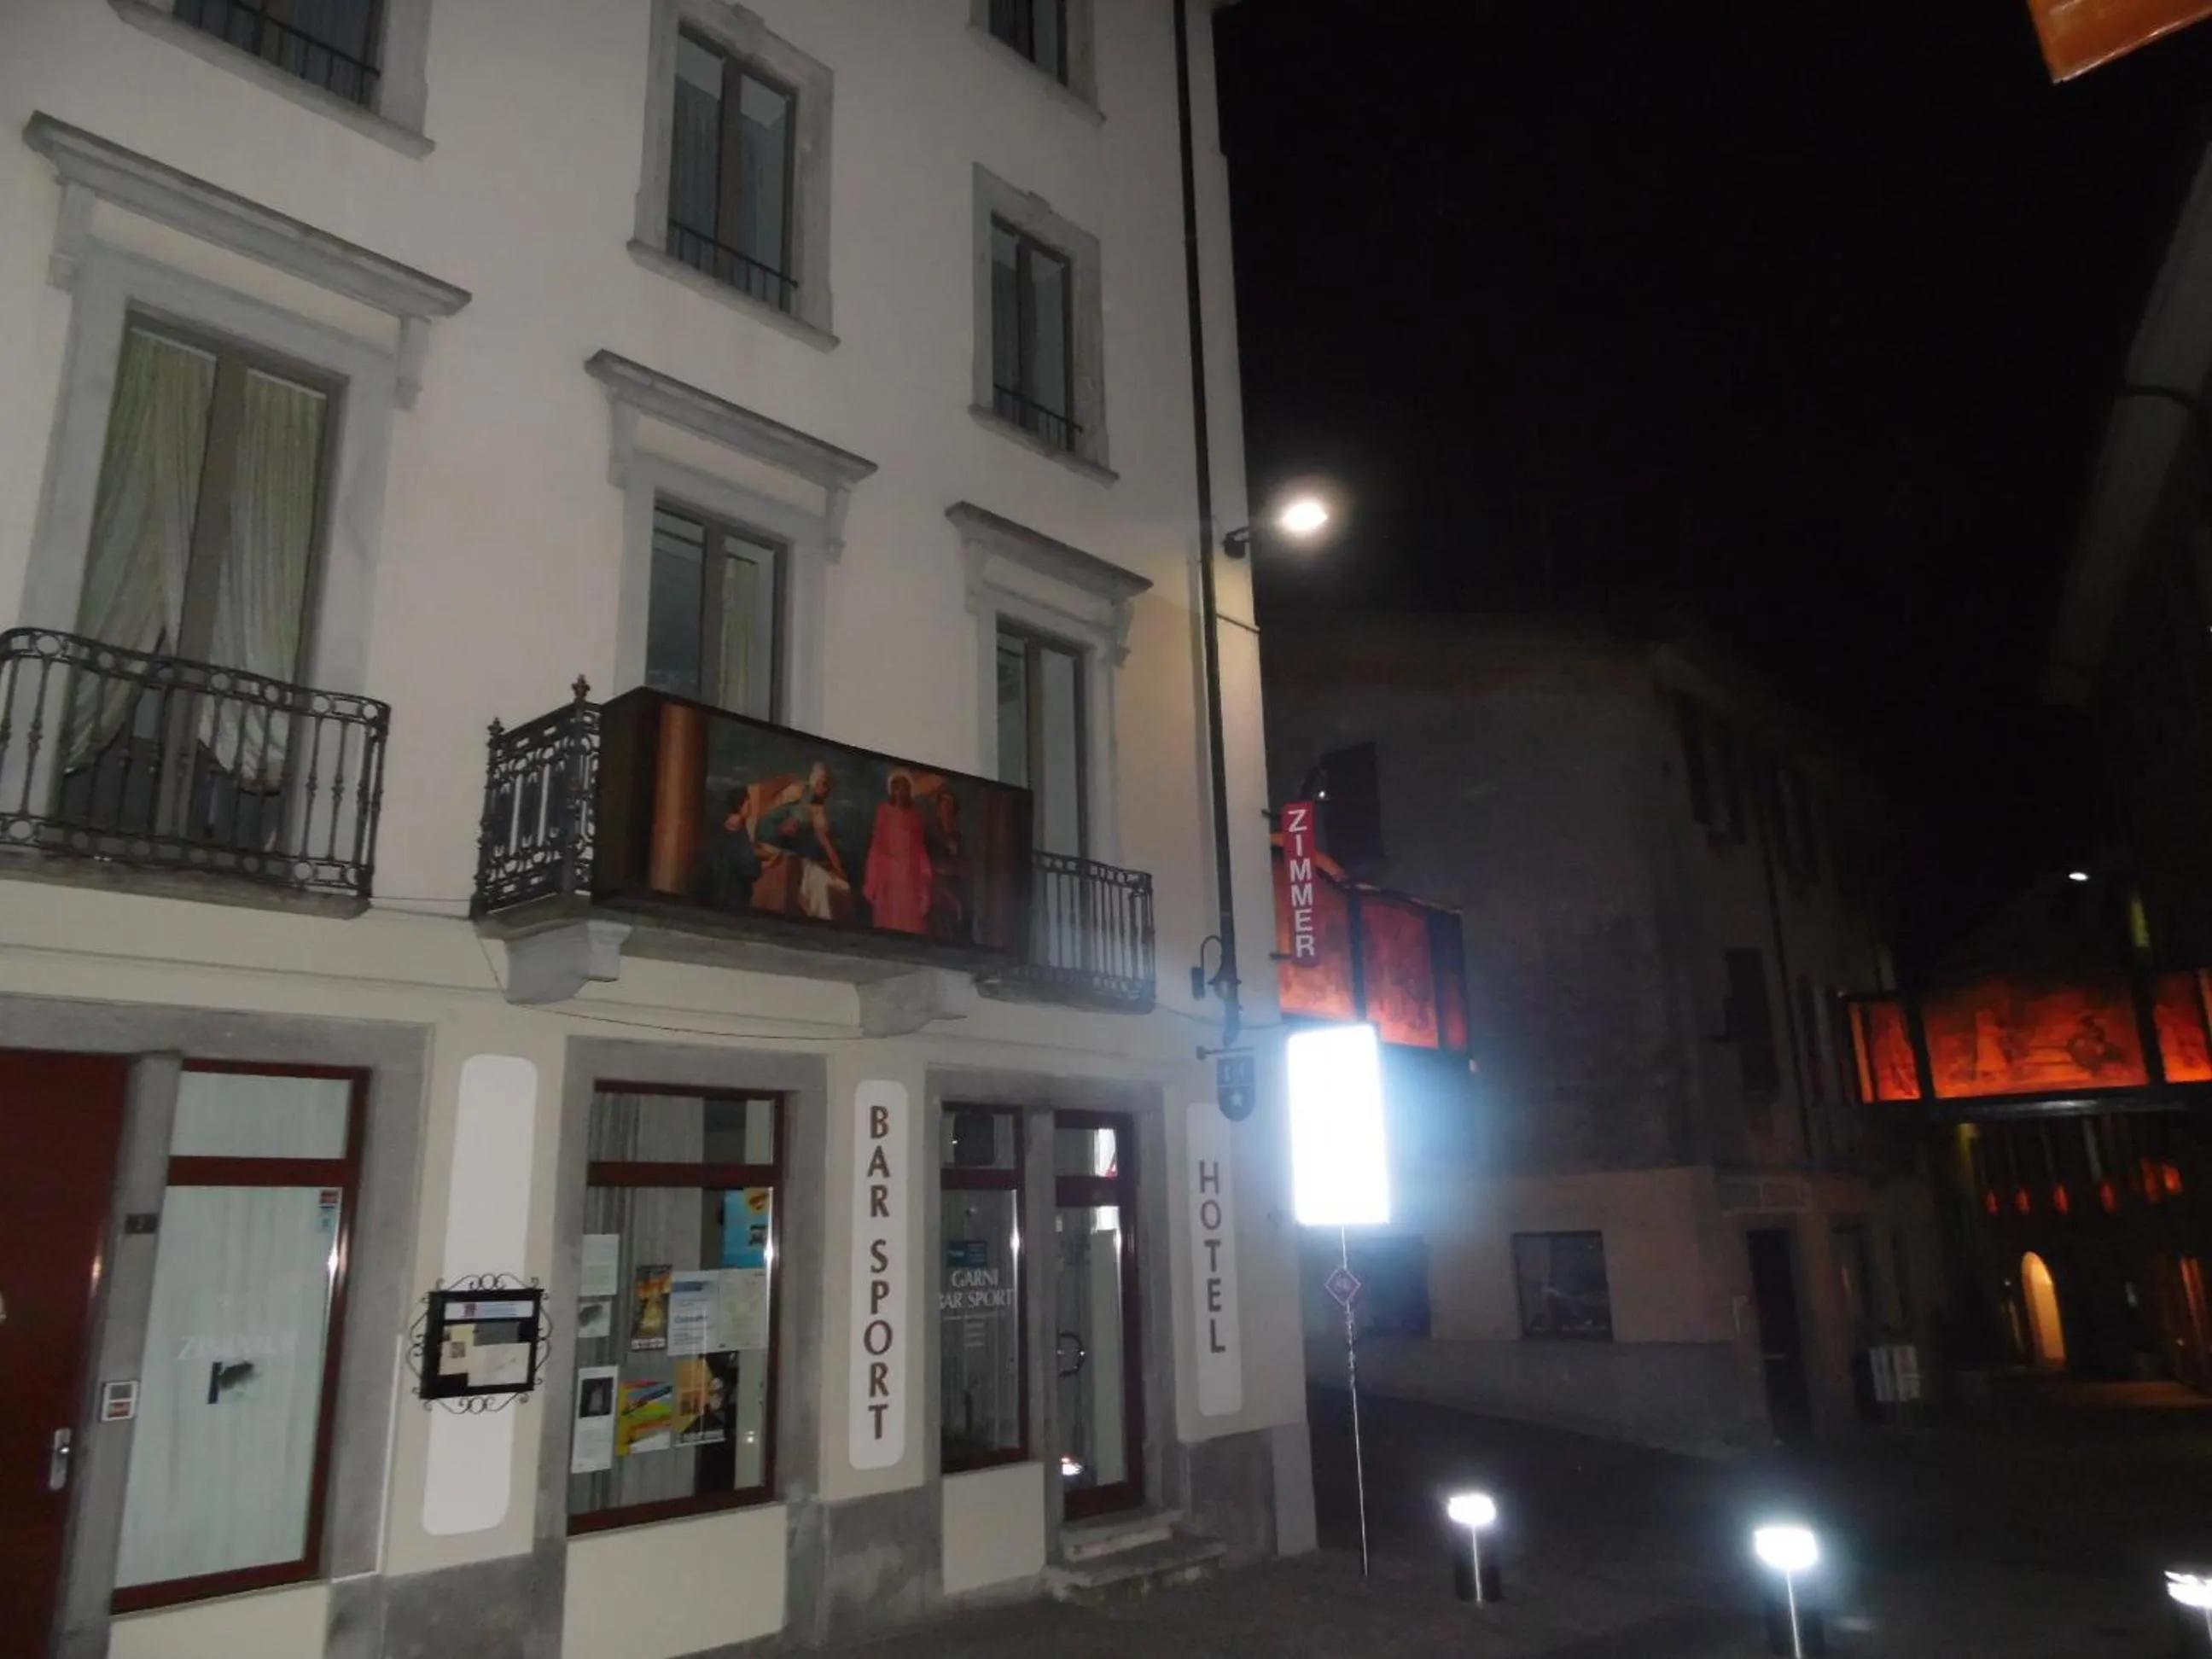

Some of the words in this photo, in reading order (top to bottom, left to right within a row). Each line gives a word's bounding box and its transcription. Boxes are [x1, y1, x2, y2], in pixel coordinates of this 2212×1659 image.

[1287, 808, 1315, 958] ZIMMER
[867, 1105, 891, 1219] BAR
[967, 1289, 1013, 1307] SPORT
[1198, 1159, 1226, 1354] HOTEL
[863, 1237, 894, 1441] SPORT
